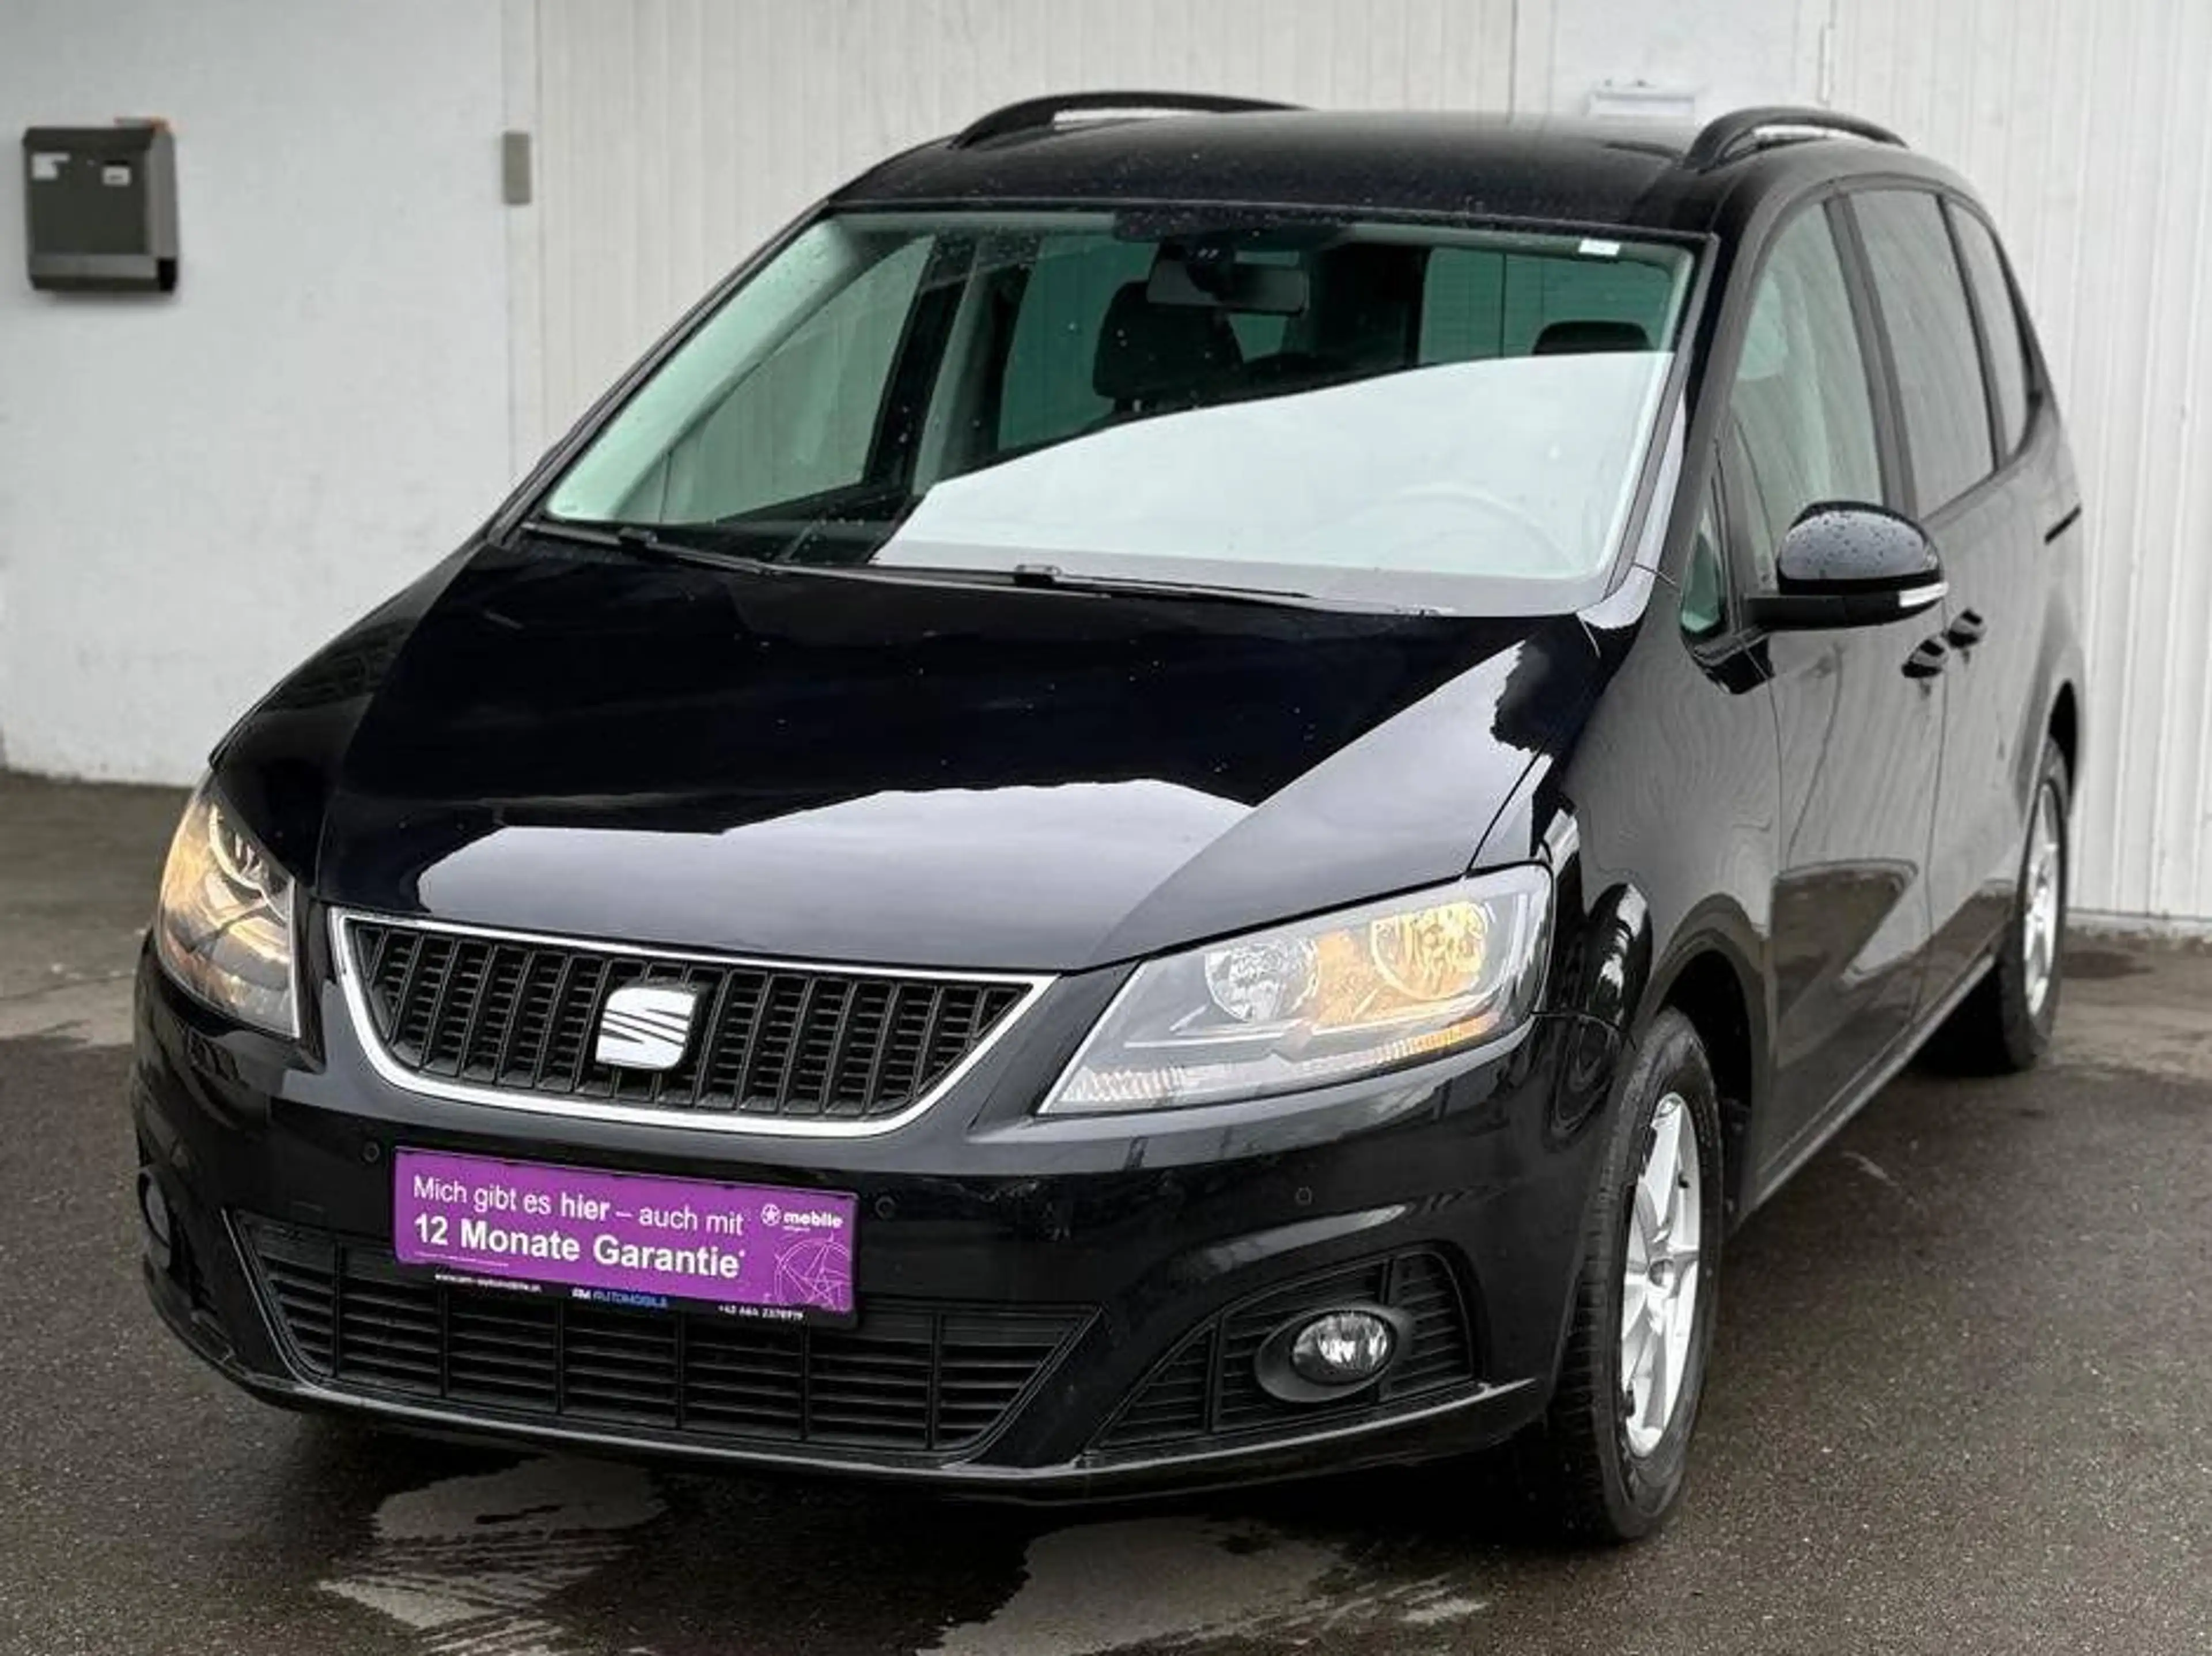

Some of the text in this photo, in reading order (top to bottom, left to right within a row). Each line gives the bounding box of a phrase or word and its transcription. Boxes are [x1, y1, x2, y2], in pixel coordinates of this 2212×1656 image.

[414, 1175, 467, 1204] Mich
[474, 1184, 517, 1214] gibt
[524, 1193, 551, 1216] es
[560, 1191, 611, 1221] hier
[639, 1204, 698, 1231] auch
[706, 1214, 744, 1236] mit
[783, 1210, 844, 1228] mobile
[414, 1212, 449, 1246] 12
[460, 1218, 580, 1261] Monate
